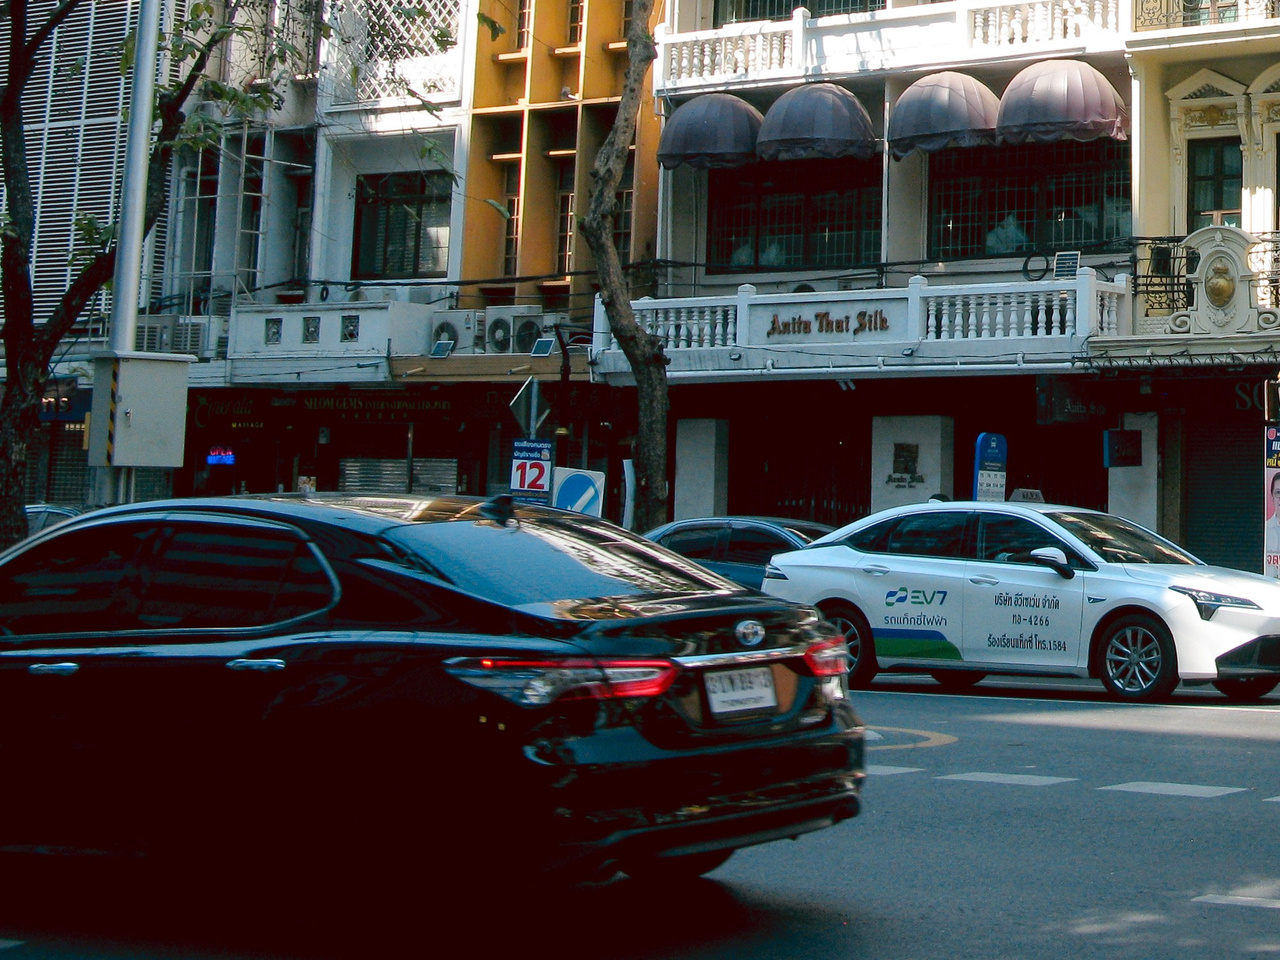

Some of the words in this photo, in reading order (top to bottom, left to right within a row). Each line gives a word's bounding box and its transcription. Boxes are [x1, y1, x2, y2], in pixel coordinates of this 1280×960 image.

[766, 314, 811, 338] Anita
[814, 311, 850, 333] Thai
[852, 309, 889, 335] Silk
[303, 396, 335, 410] SILOM
[336, 396, 363, 410] GEMS
[516, 461, 546, 490] 12
[911, 590, 948, 606] EV7
[994, 592, 1013, 607] บริษัท
[1041, 595, 1060, 610] จำกัด
[884, 612, 948, 627] รถแท็กซี่ไฟฟ้า
